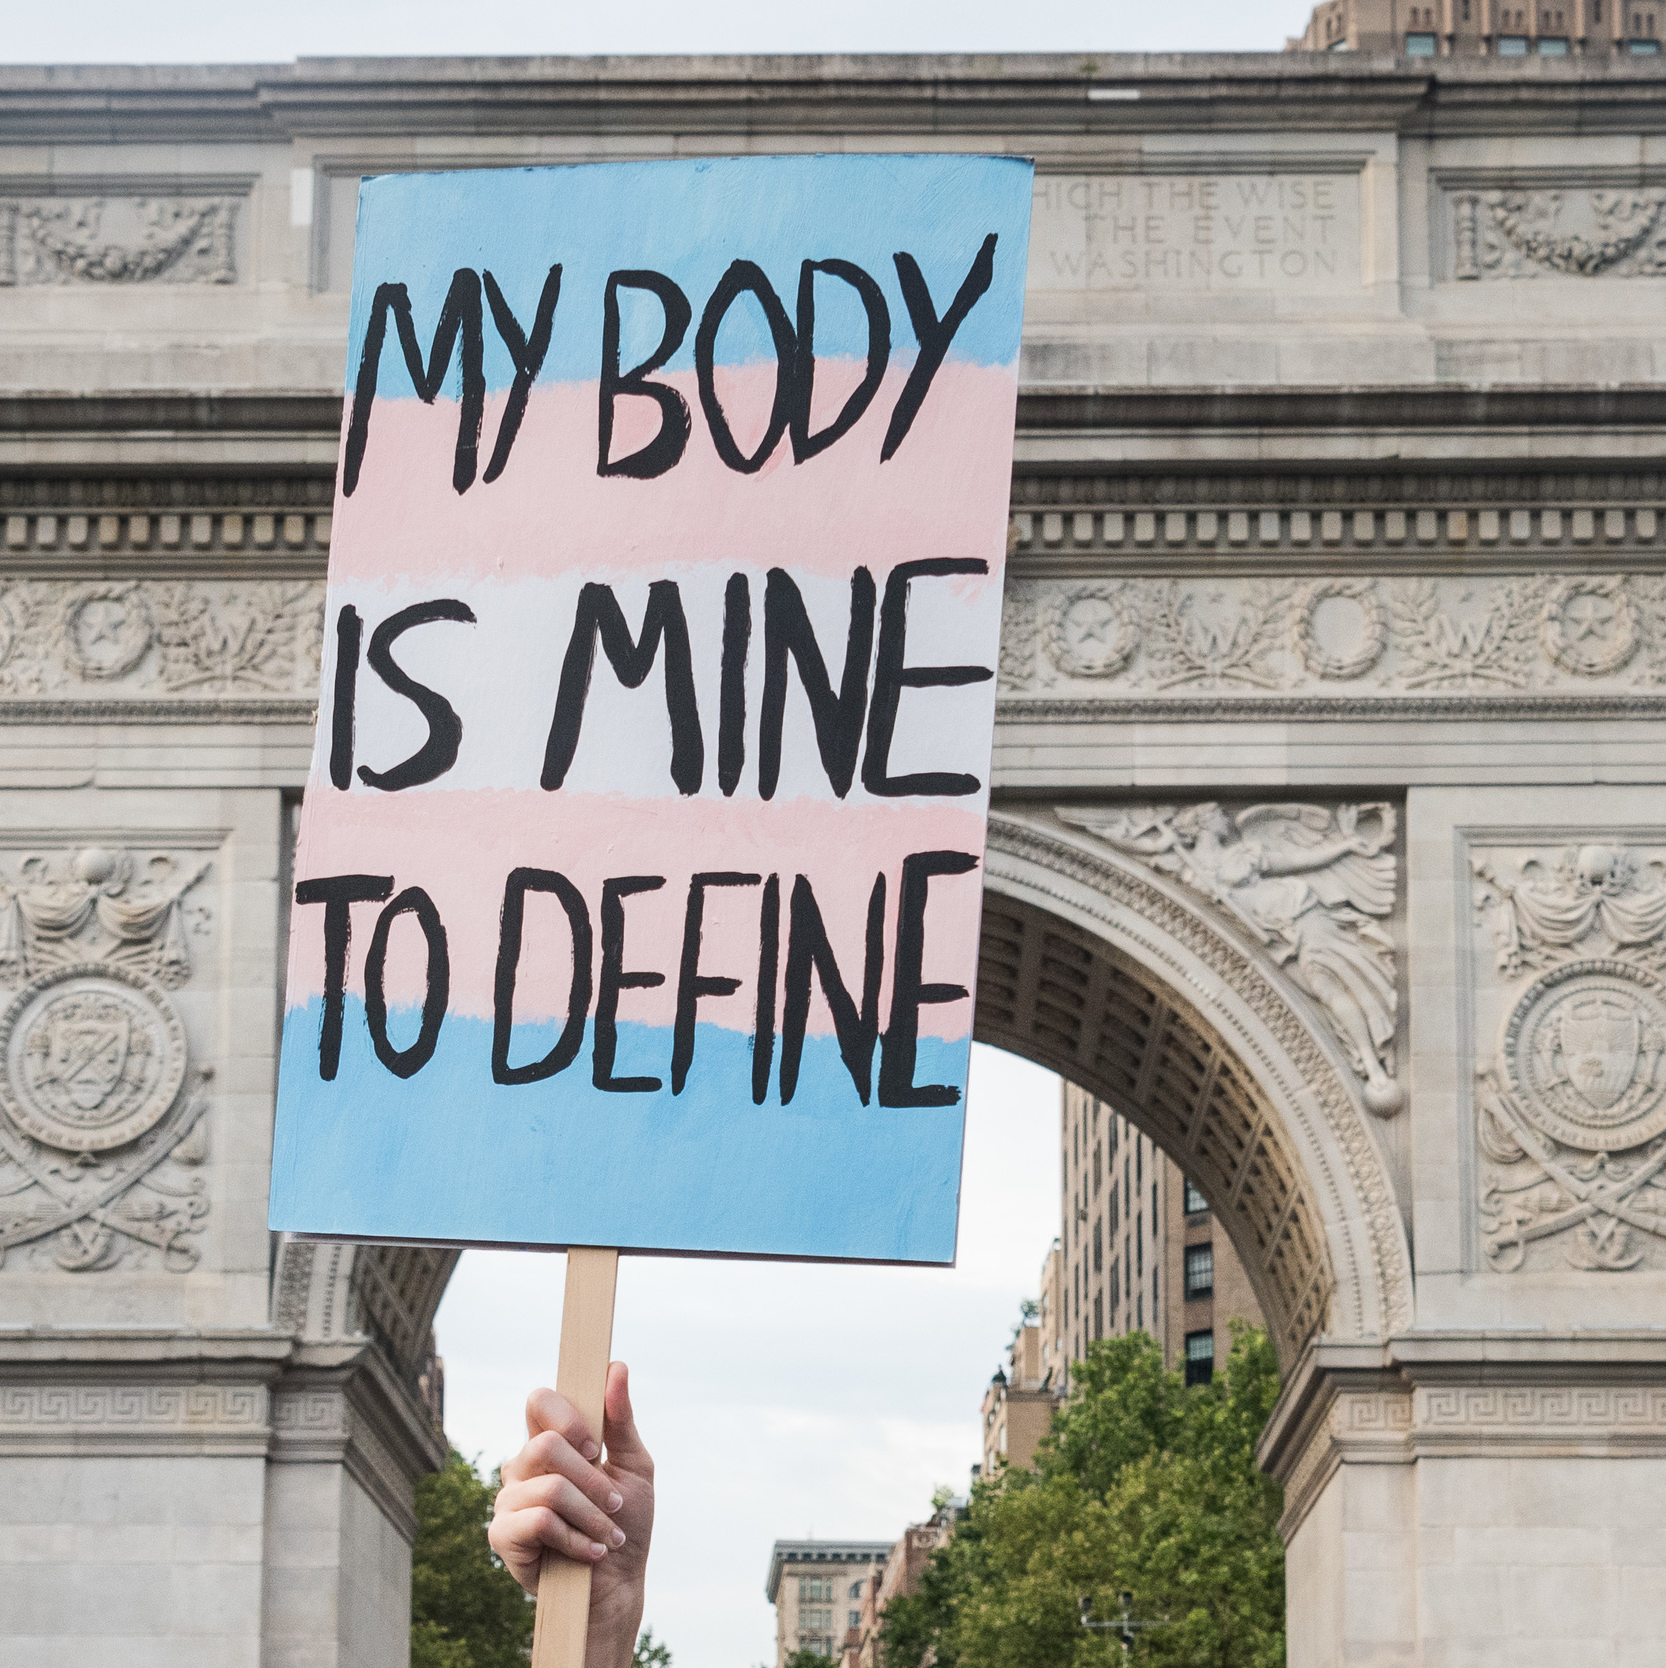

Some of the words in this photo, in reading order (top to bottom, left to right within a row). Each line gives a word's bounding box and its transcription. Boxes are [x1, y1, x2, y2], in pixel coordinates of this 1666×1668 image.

[1084, 213, 1165, 245] THE
[1194, 213, 1335, 245] EVENT
[1141, 180, 1219, 210] THE
[1236, 180, 1333, 210] WISE
[1049, 250, 1336, 279] WASHINGTON
[343, 264, 562, 497] MY
[597, 232, 999, 479] BODY
[330, 599, 478, 792] IS
[541, 557, 994, 801] MINE
[295, 874, 450, 1081] TO
[491, 851, 981, 1108] DEFINE
